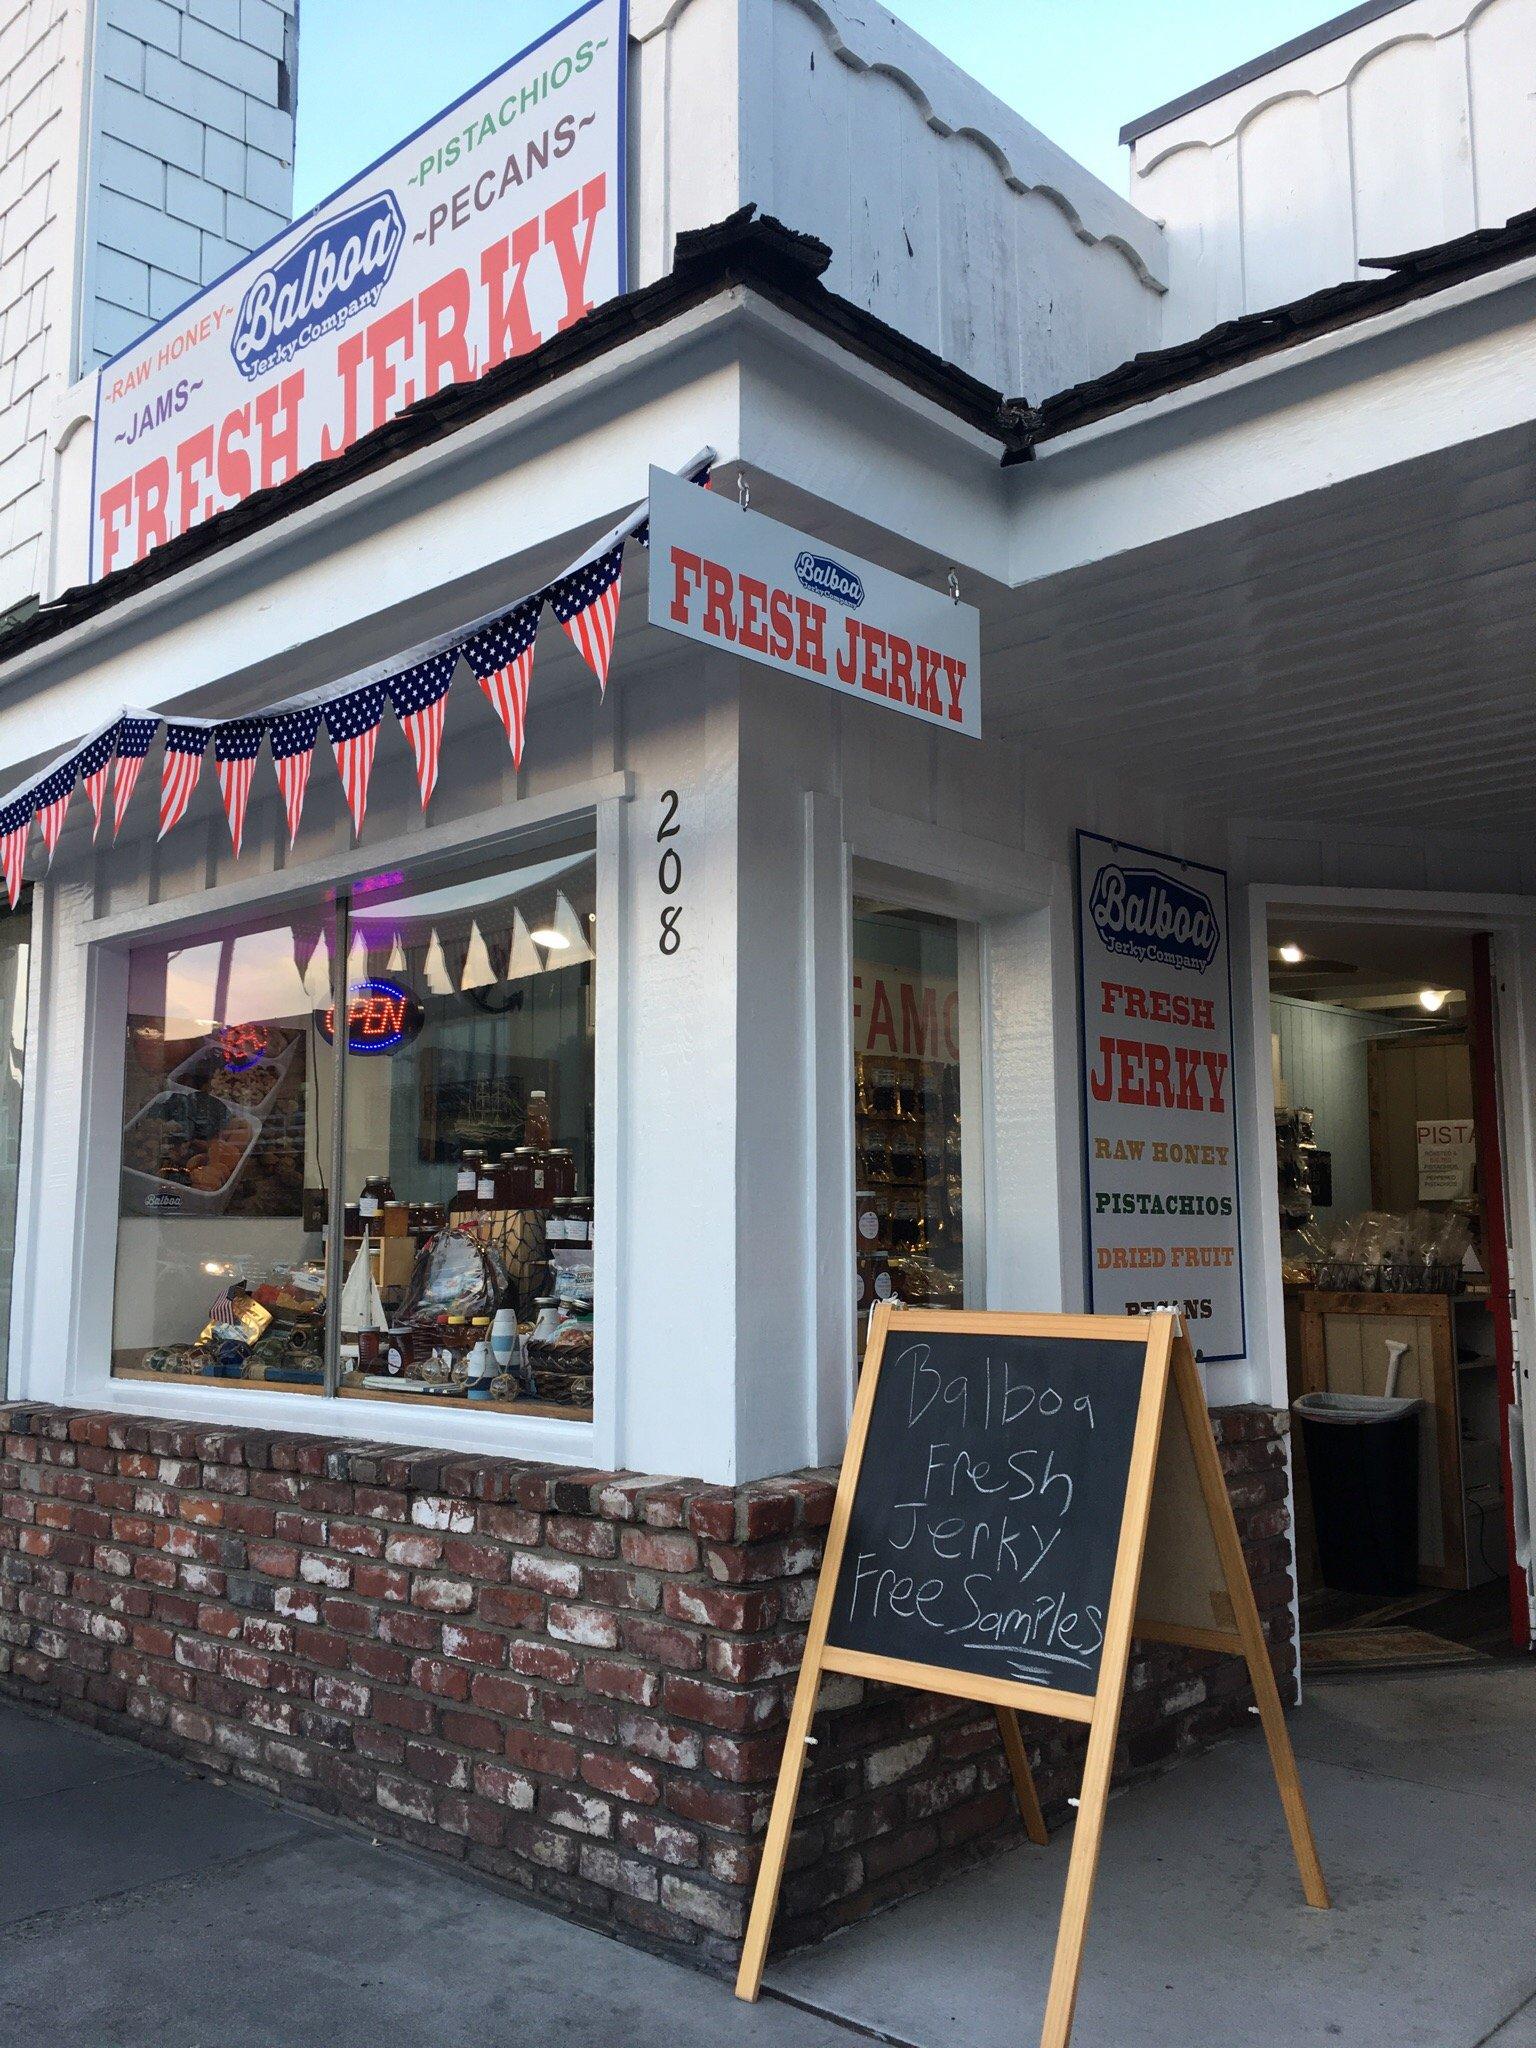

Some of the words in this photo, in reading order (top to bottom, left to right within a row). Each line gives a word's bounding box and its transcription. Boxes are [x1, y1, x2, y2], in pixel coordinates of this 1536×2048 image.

[236, 212, 398, 362] Balboa
[249, 338, 299, 382] Jerky
[299, 281, 385, 349] Company
[100, 368, 305, 578] FRESH
[320, 171, 606, 461] JERKY
[796, 552, 862, 600] Balboa
[669, 545, 827, 675] FRESH
[836, 616, 967, 723] JERKY
[657, 790, 682, 956] 208
[1094, 866, 1216, 949] Balboa
[1106, 936, 1146, 963] Jerky
[1147, 944, 1208, 975] Company
[1101, 981, 1215, 1030] FRESH
[1091, 1036, 1228, 1113] JERKY
[1094, 1137, 1145, 1161] RAW
[1152, 1142, 1229, 1166] HONEY
[1095, 1192, 1233, 1216] PISTACHIOS
[1097, 1247, 1166, 1269] DRIED
[1171, 1246, 1234, 1268] FRUIT
[1125, 1299, 1213, 1319] PNS
[895, 1343, 1095, 1429] Balboa
[889, 1503, 1061, 1582] Jerky
[850, 1553, 944, 1627] Free
